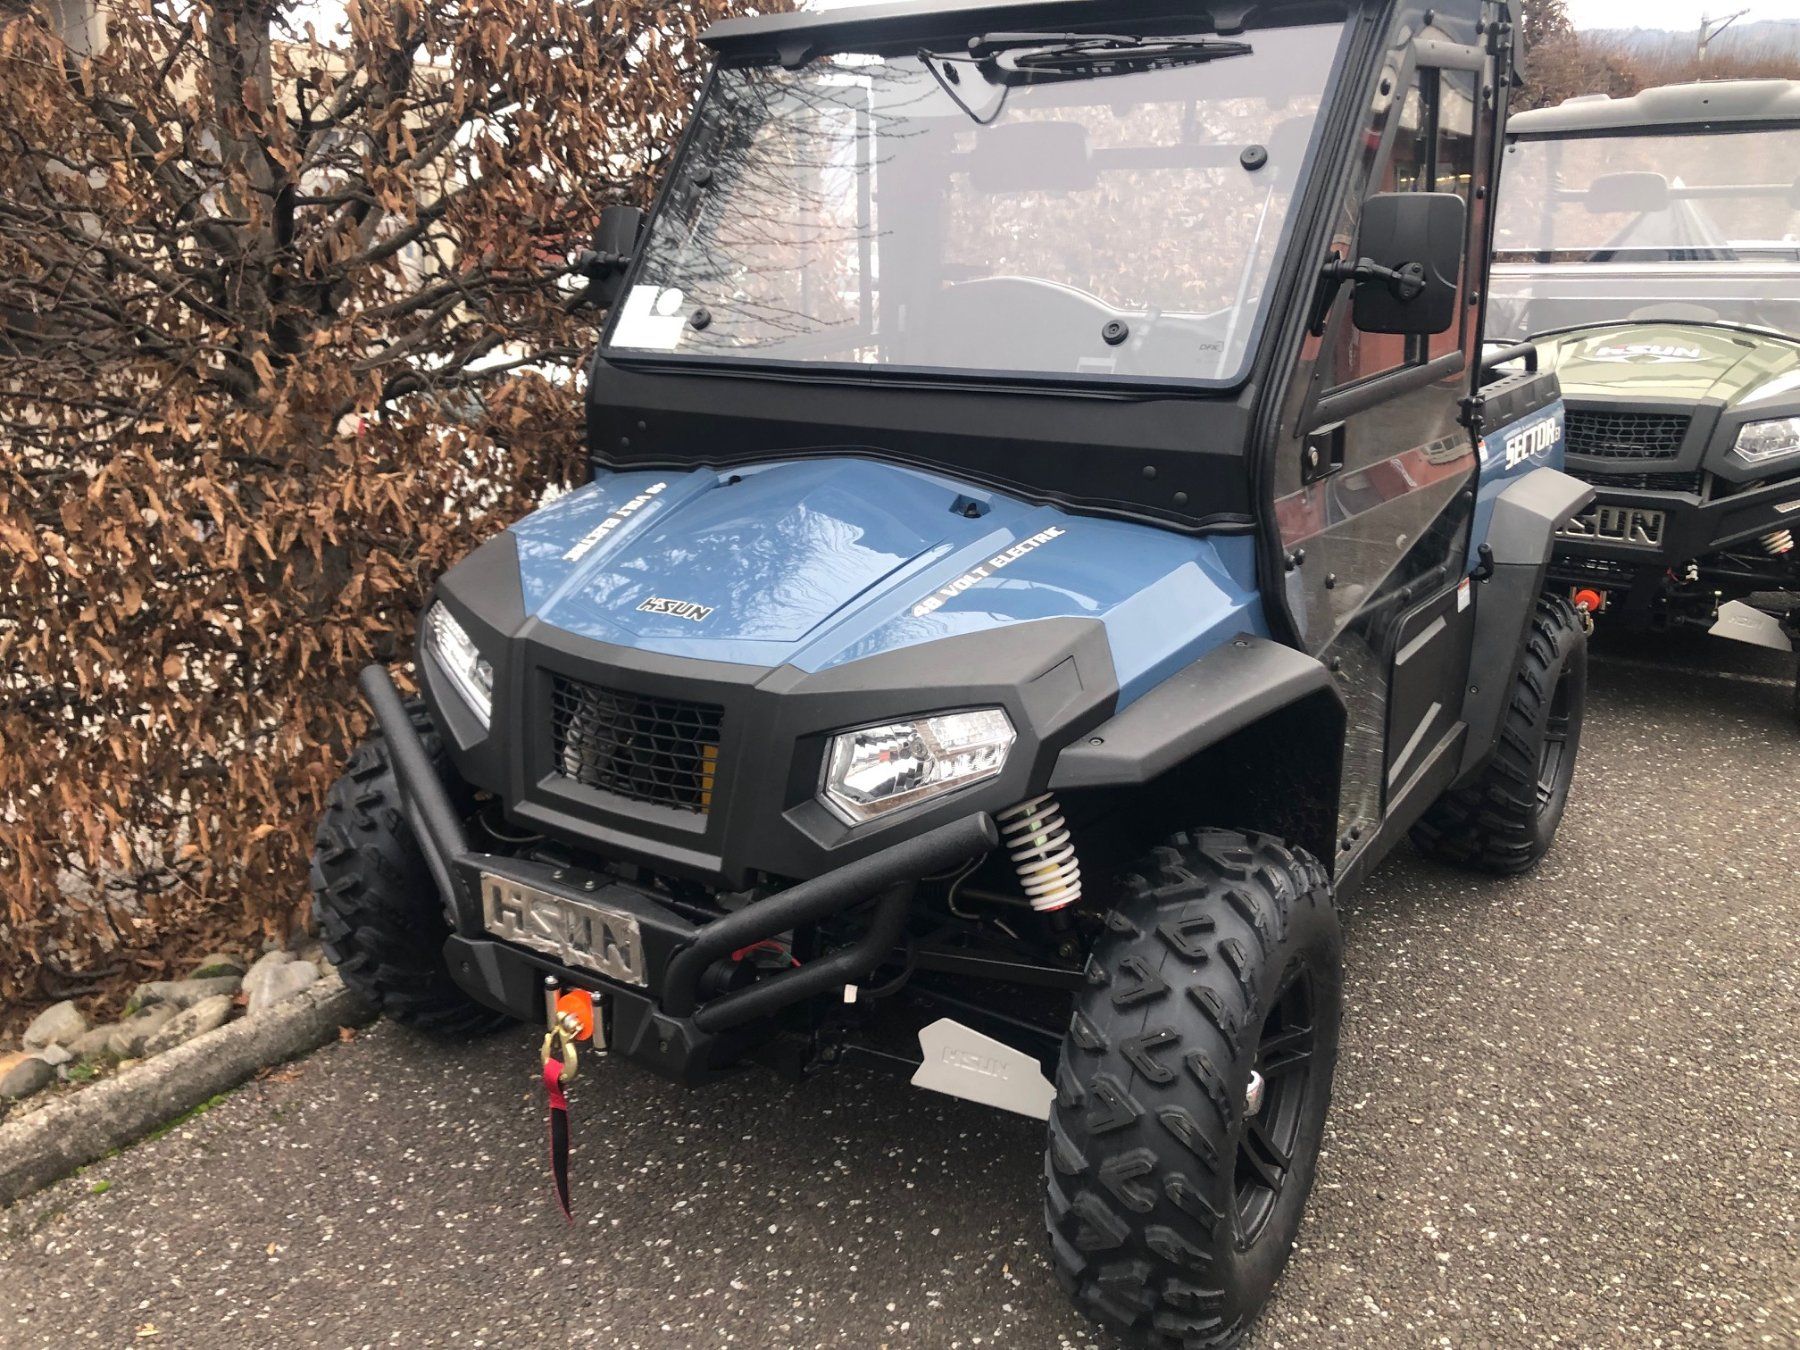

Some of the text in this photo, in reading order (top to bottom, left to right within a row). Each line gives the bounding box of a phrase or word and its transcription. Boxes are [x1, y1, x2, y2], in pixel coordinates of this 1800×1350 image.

[1505, 417, 1556, 471] SECTOR
[1555, 507, 1660, 545] SUN
[940, 567, 990, 597] VOLT
[636, 598, 714, 622] HSUN
[490, 883, 634, 975] HSUN
